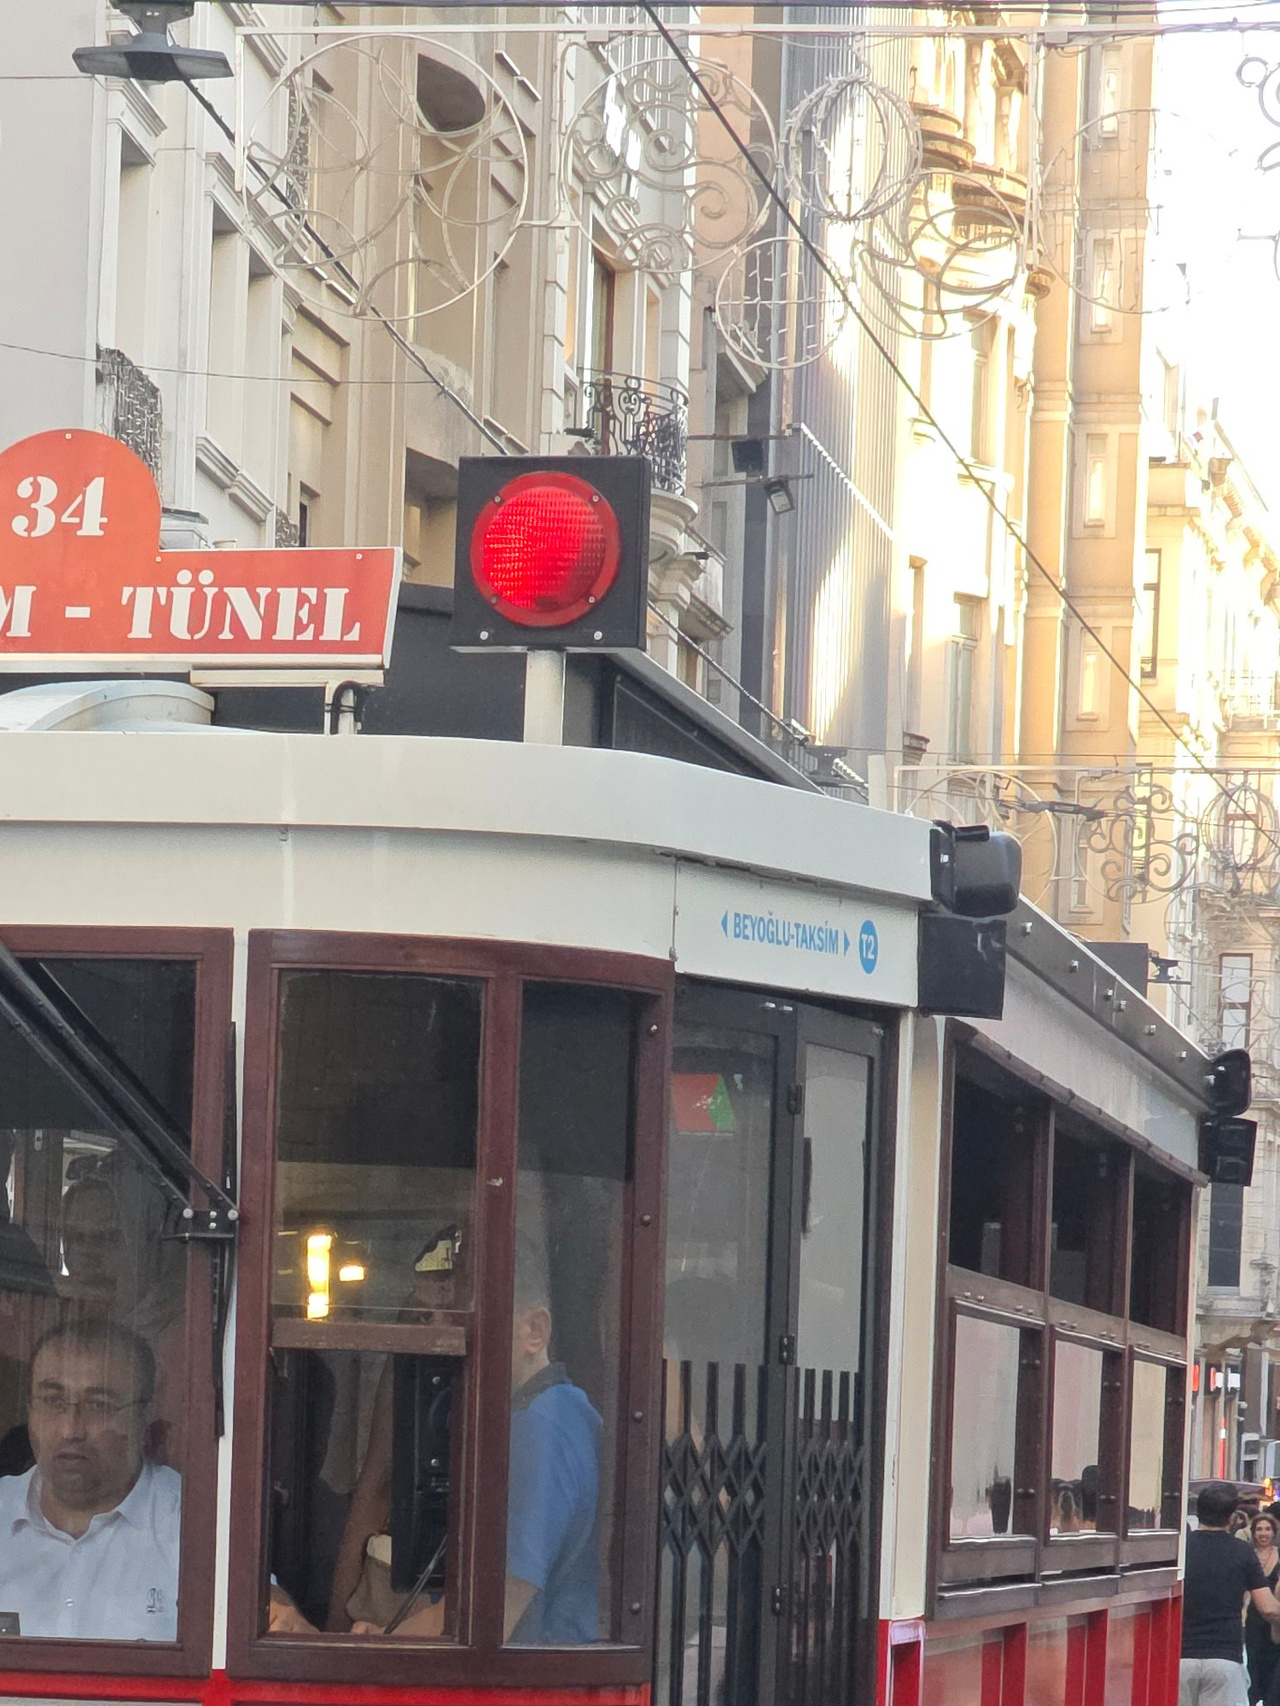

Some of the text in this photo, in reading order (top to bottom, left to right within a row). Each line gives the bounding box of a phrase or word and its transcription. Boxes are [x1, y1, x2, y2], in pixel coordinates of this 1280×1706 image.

[11, 475, 109, 539] 34
[64, 605, 91, 618] -
[120, 569, 362, 641] TÜNEL
[733, 909, 876, 960] BEYOĞLU-TAKSİM T2
